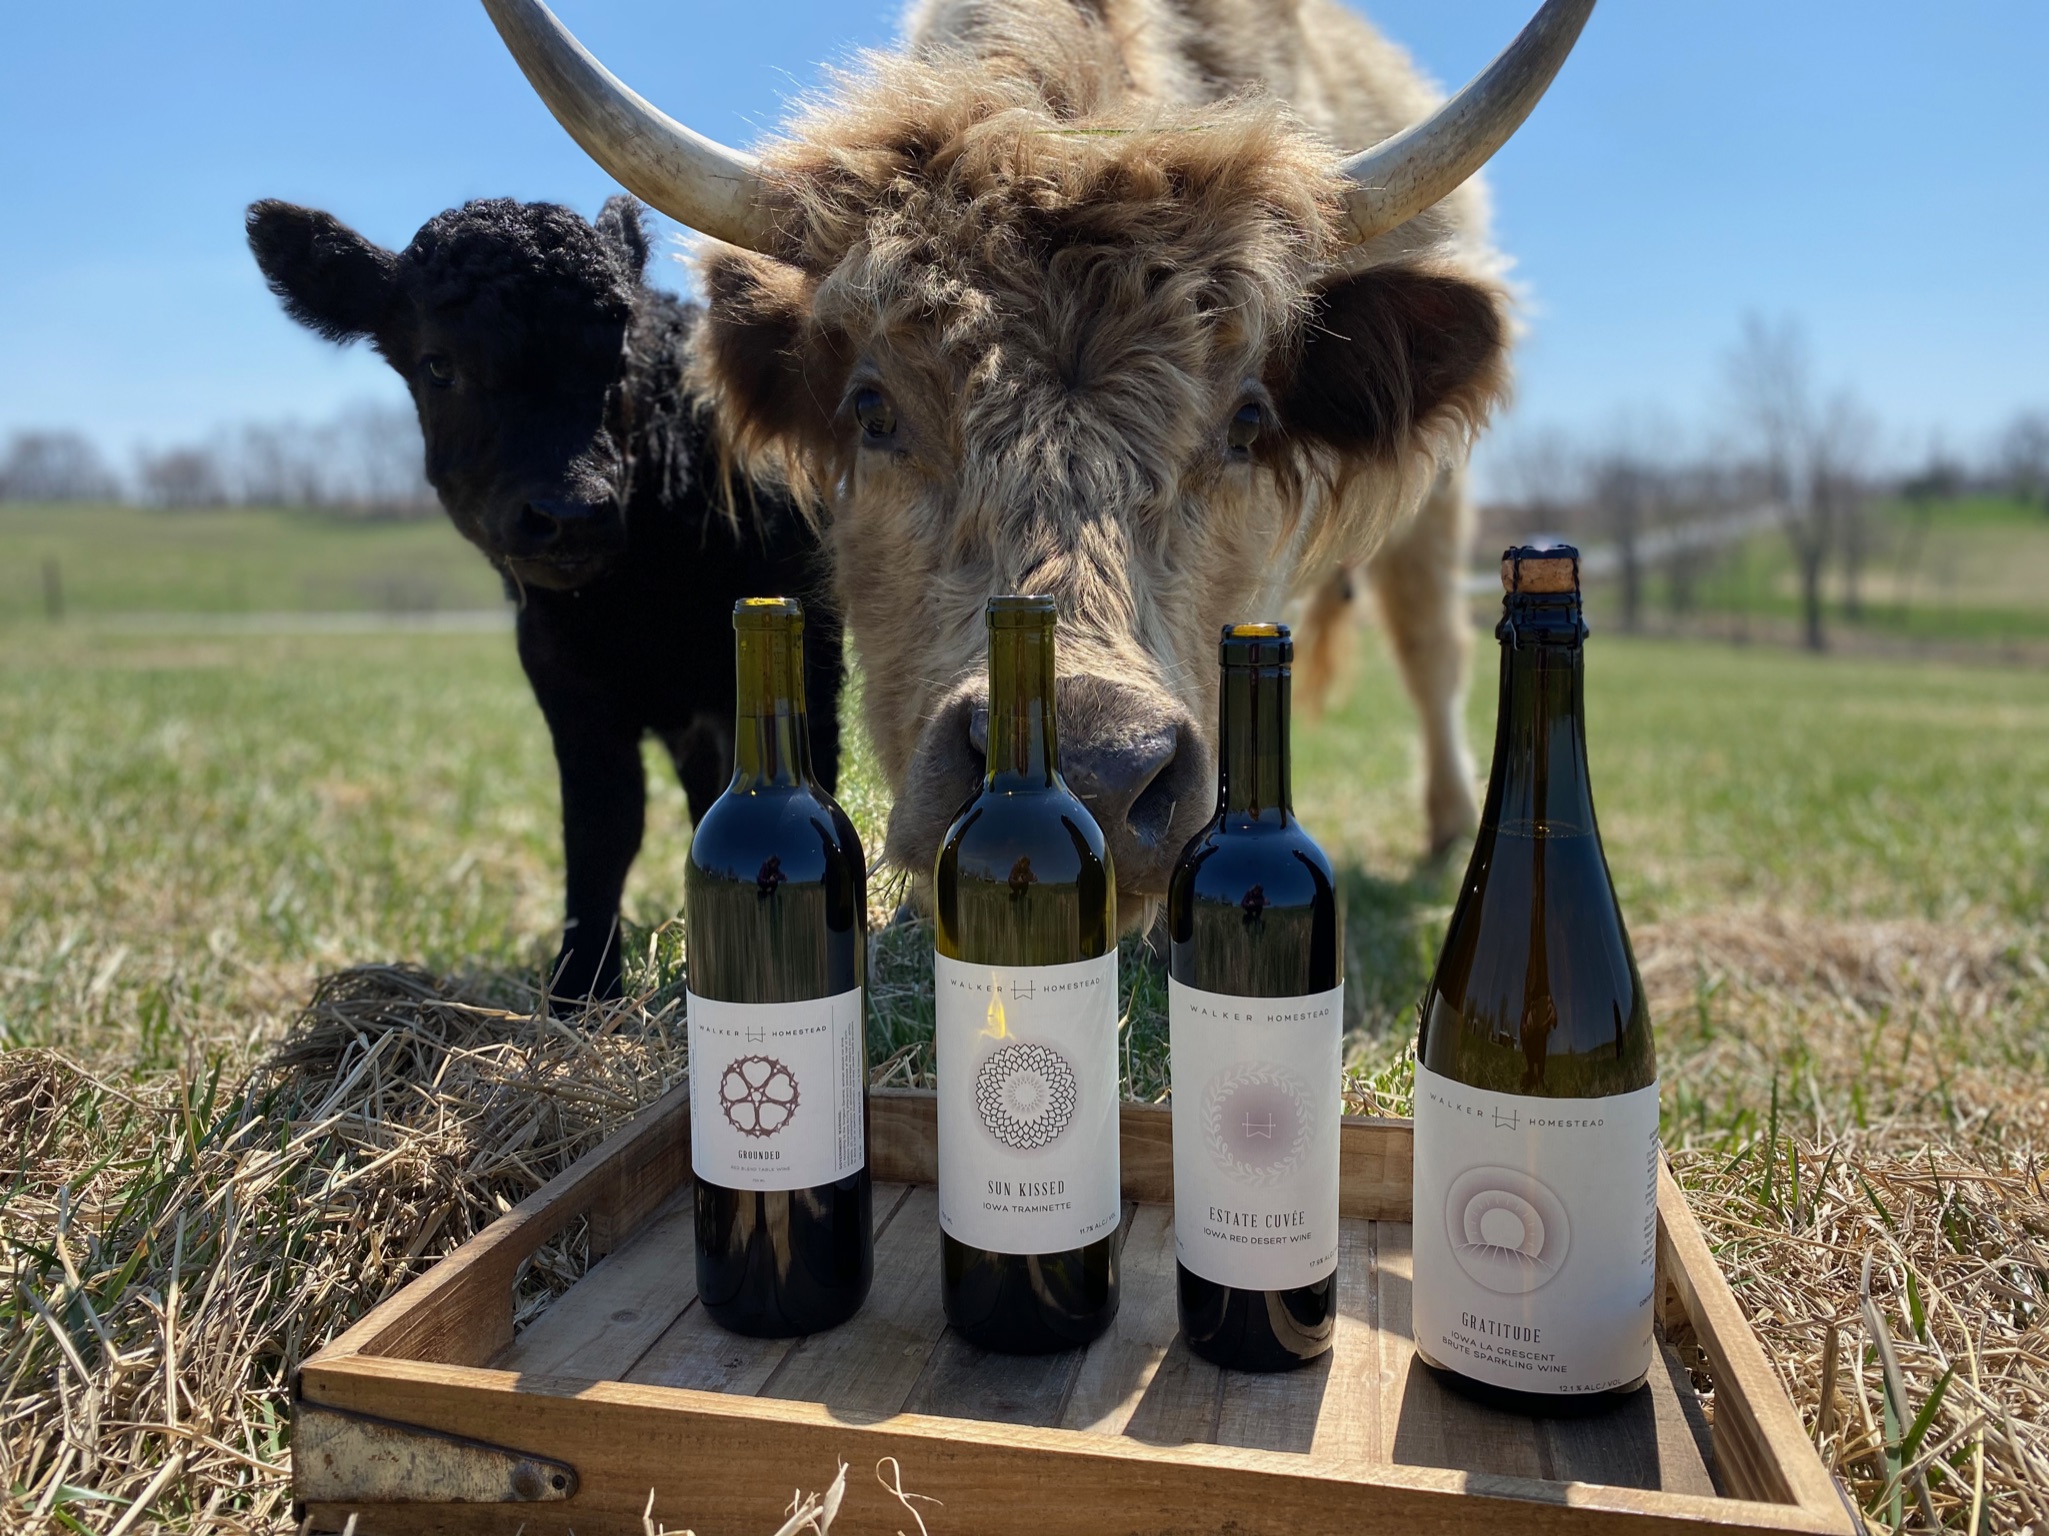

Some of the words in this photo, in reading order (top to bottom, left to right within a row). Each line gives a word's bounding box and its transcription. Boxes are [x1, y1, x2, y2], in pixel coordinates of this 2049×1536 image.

[950, 978, 1003, 993] WALKER
[1043, 977, 1101, 993] HOMESTEAD
[1190, 1005, 1253, 1021] WALKER
[1267, 1008, 1329, 1022] HOMESTEAD
[699, 1025, 740, 1037] WALKER
[772, 1025, 828, 1037] HOMESTEAD
[1430, 1092, 1484, 1118] WALKER
[1529, 1118, 1604, 1128] HOMESTEAD
[738, 1150, 781, 1160] GROUNDED
[988, 1180, 1012, 1198] SUN
[1019, 1180, 1065, 1198] KISSED
[983, 1201, 1009, 1213] IOWA
[1012, 1201, 1072, 1213] TRAMINETTE
[1209, 1206, 1258, 1229] ESTATE
[1265, 1209, 1306, 1229] CUVÉE
[1203, 1227, 1228, 1241] IOWA
[1229, 1234, 1248, 1244] RED
[1250, 1236, 1288, 1245] DESERT
[1289, 1231, 1313, 1243] WINE
[1462, 1311, 1542, 1344] GRATITUDE
[1442, 1335, 1471, 1356] BRUTE
[1473, 1350, 1534, 1371] SPARKLING
[1537, 1364, 1568, 1373] WINE
[1451, 1330, 1477, 1348] IOWA
[1480, 1342, 1493, 1352] LA
[1497, 1346, 1556, 1363] CRESCENT
[1607, 1378, 1622, 1387] VOL
